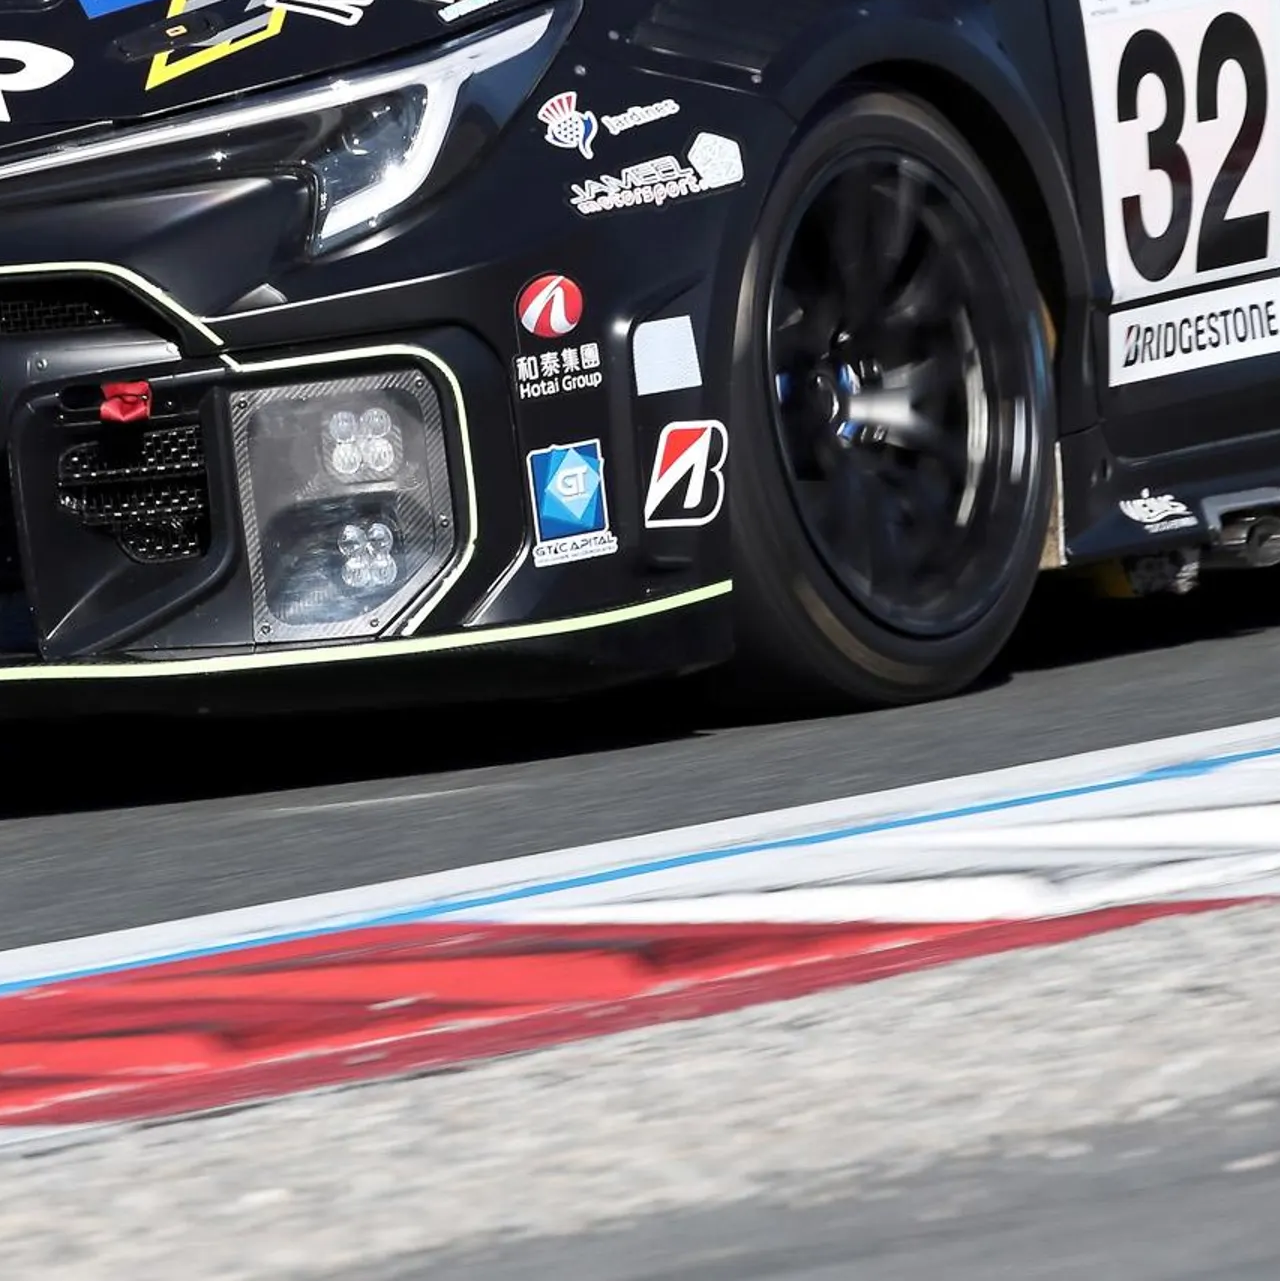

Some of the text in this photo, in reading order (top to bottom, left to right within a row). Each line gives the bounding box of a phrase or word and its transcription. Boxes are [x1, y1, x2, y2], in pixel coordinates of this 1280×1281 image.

[1116, 11, 1270, 282] 32
[571, 155, 694, 205] JAMEEL
[1123, 300, 1280, 368] BRIDGESTONE
[516, 342, 601, 382] 和泰集團
[520, 371, 602, 400] Hotai Group
[555, 464, 589, 498] GT
